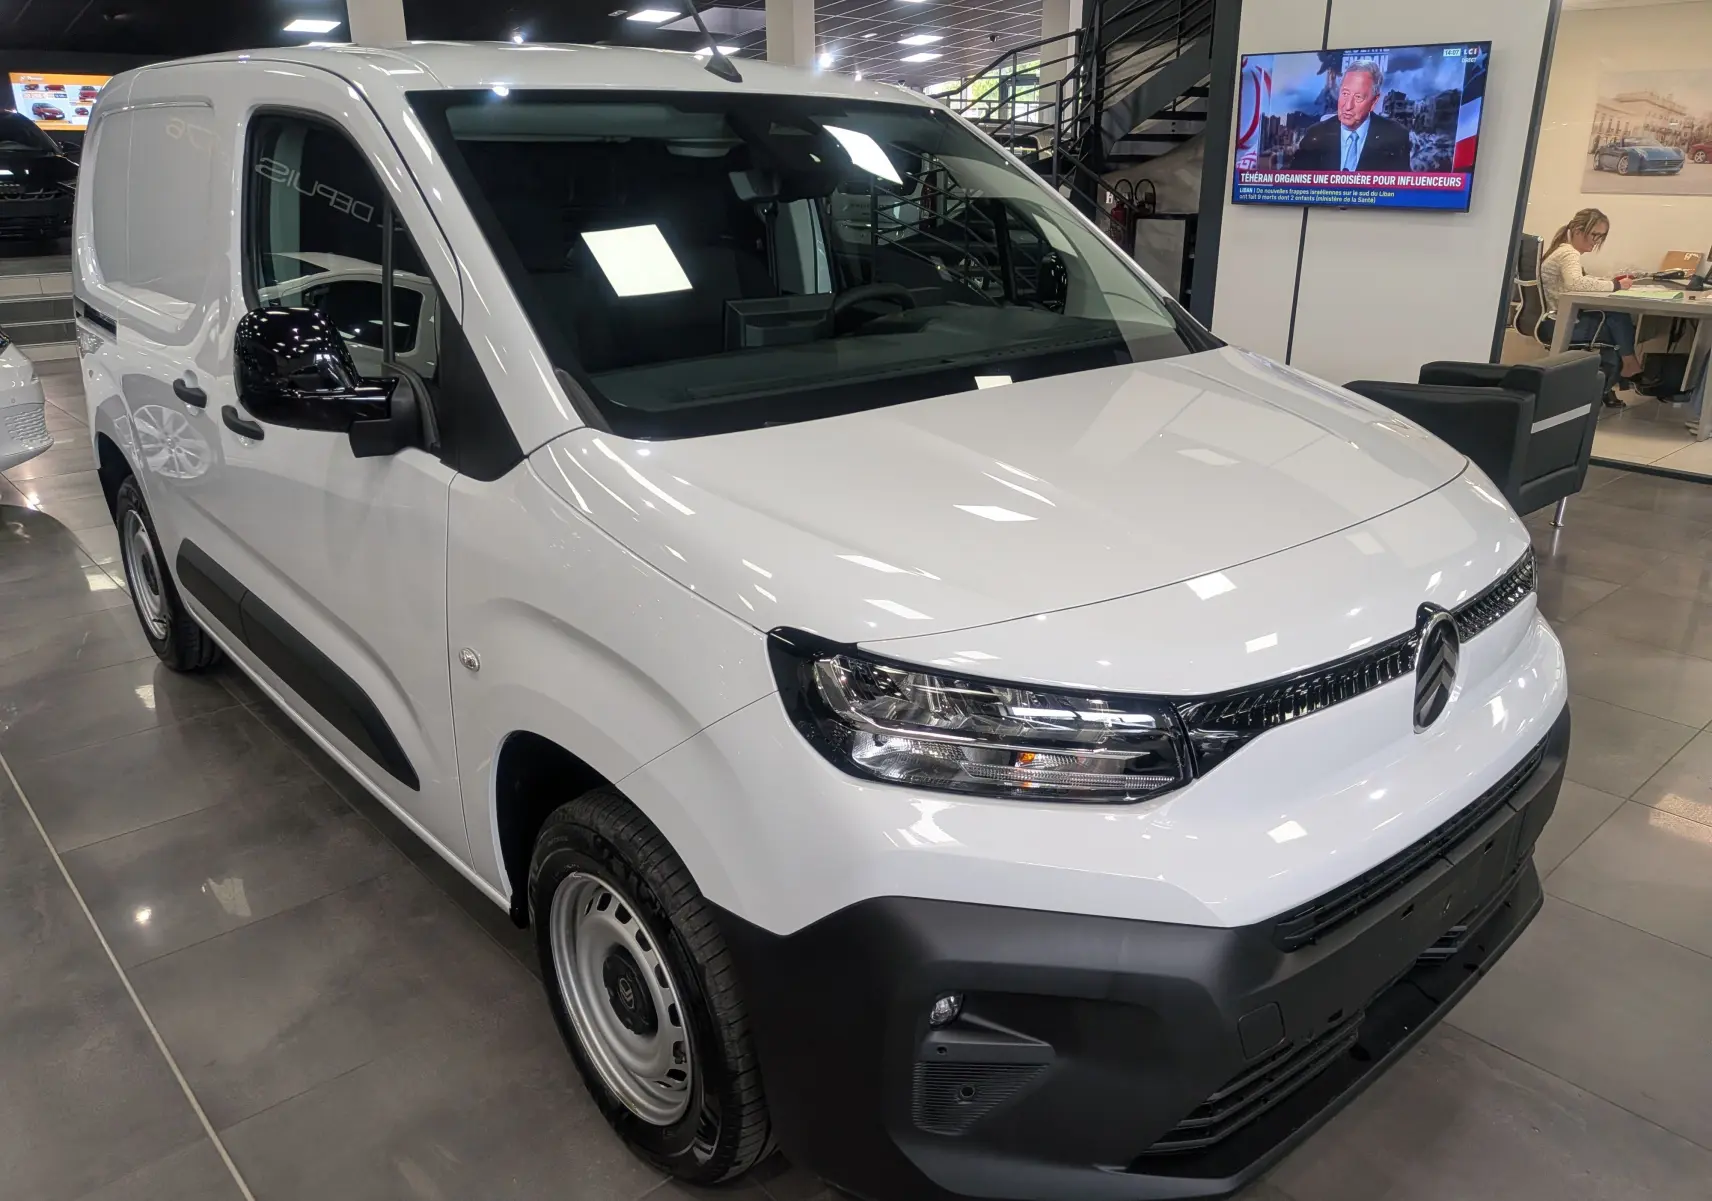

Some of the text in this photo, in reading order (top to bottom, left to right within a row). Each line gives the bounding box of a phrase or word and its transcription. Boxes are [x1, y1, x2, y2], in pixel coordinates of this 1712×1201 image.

[1240, 171, 1462, 187] TÉHÉRAN ORGANISE UNE CROISIÈRE POUR INFLUENCEURS
